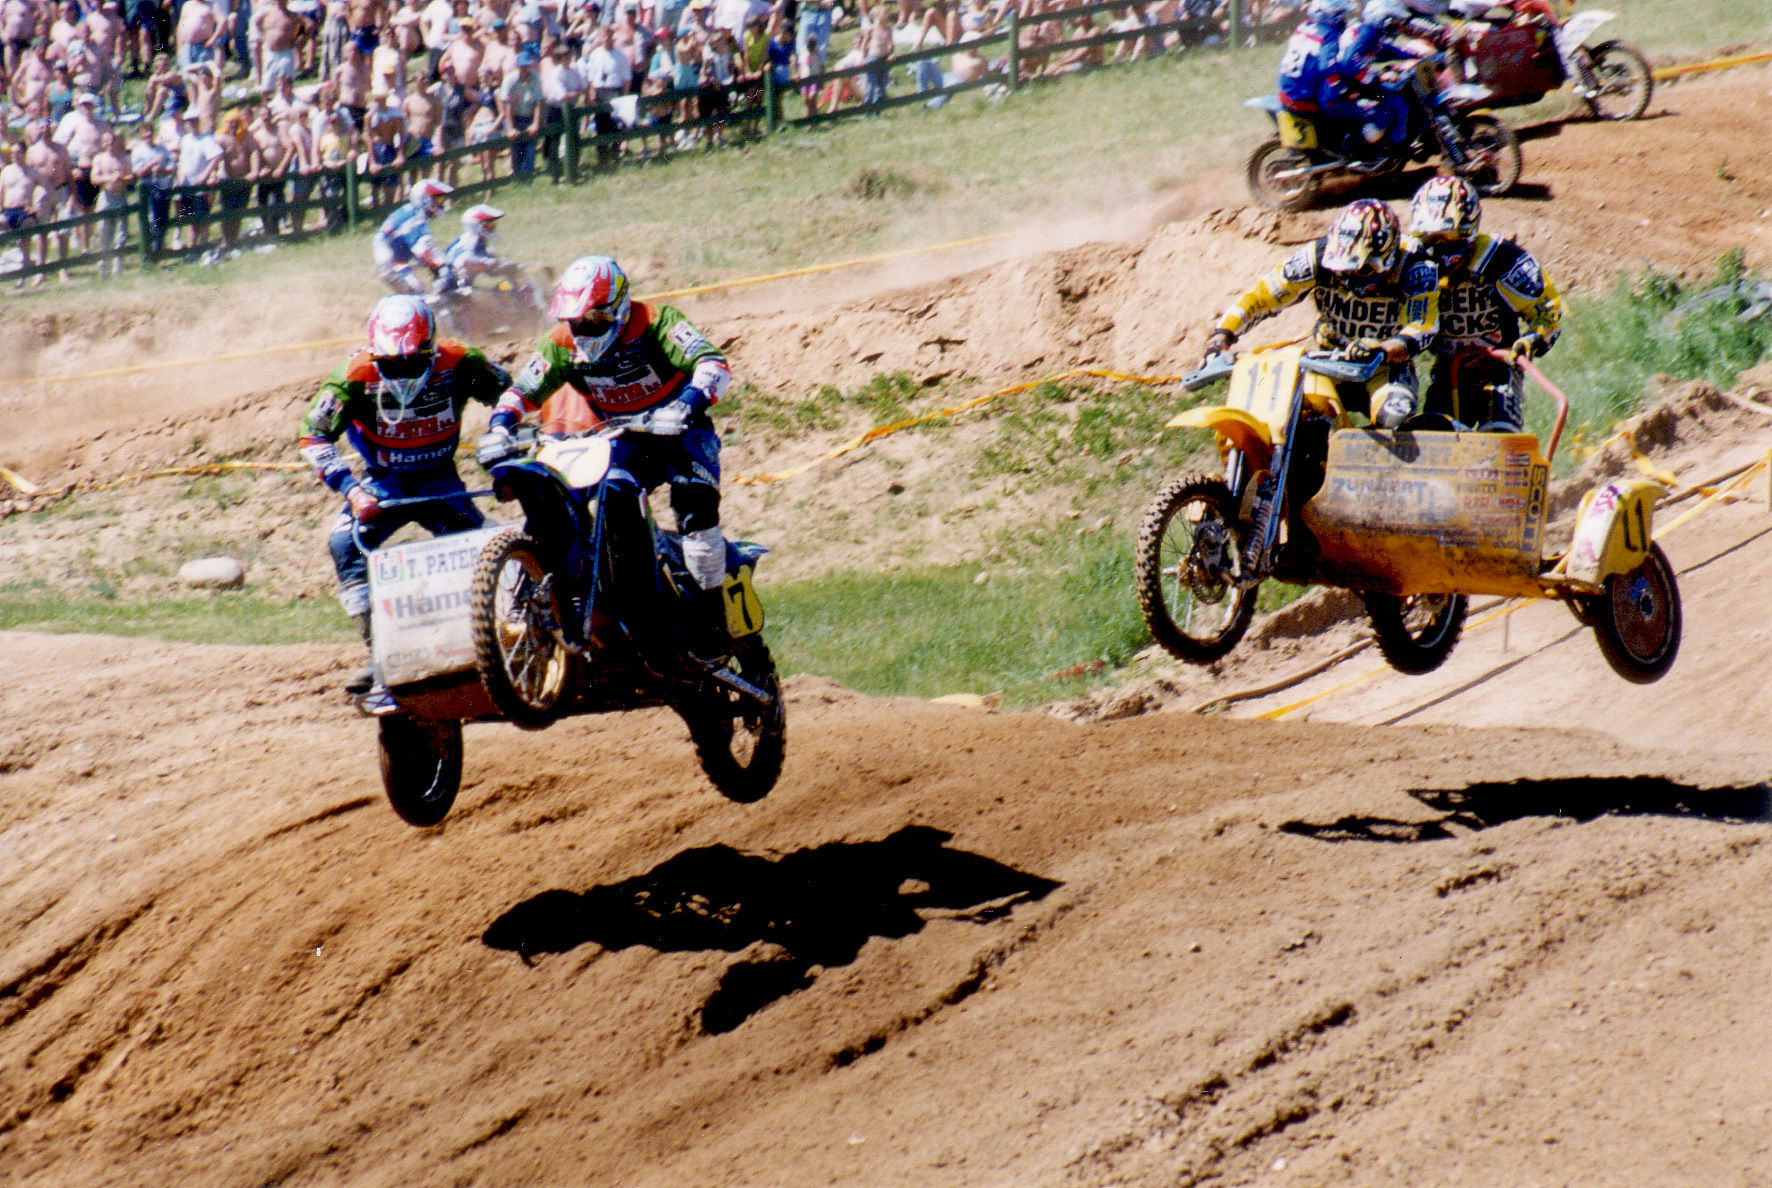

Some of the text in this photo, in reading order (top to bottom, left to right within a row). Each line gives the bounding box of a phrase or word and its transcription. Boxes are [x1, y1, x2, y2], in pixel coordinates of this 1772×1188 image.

[1245, 360, 1283, 412] 11
[555, 446, 590, 477] 7
[727, 582, 754, 631] 7
